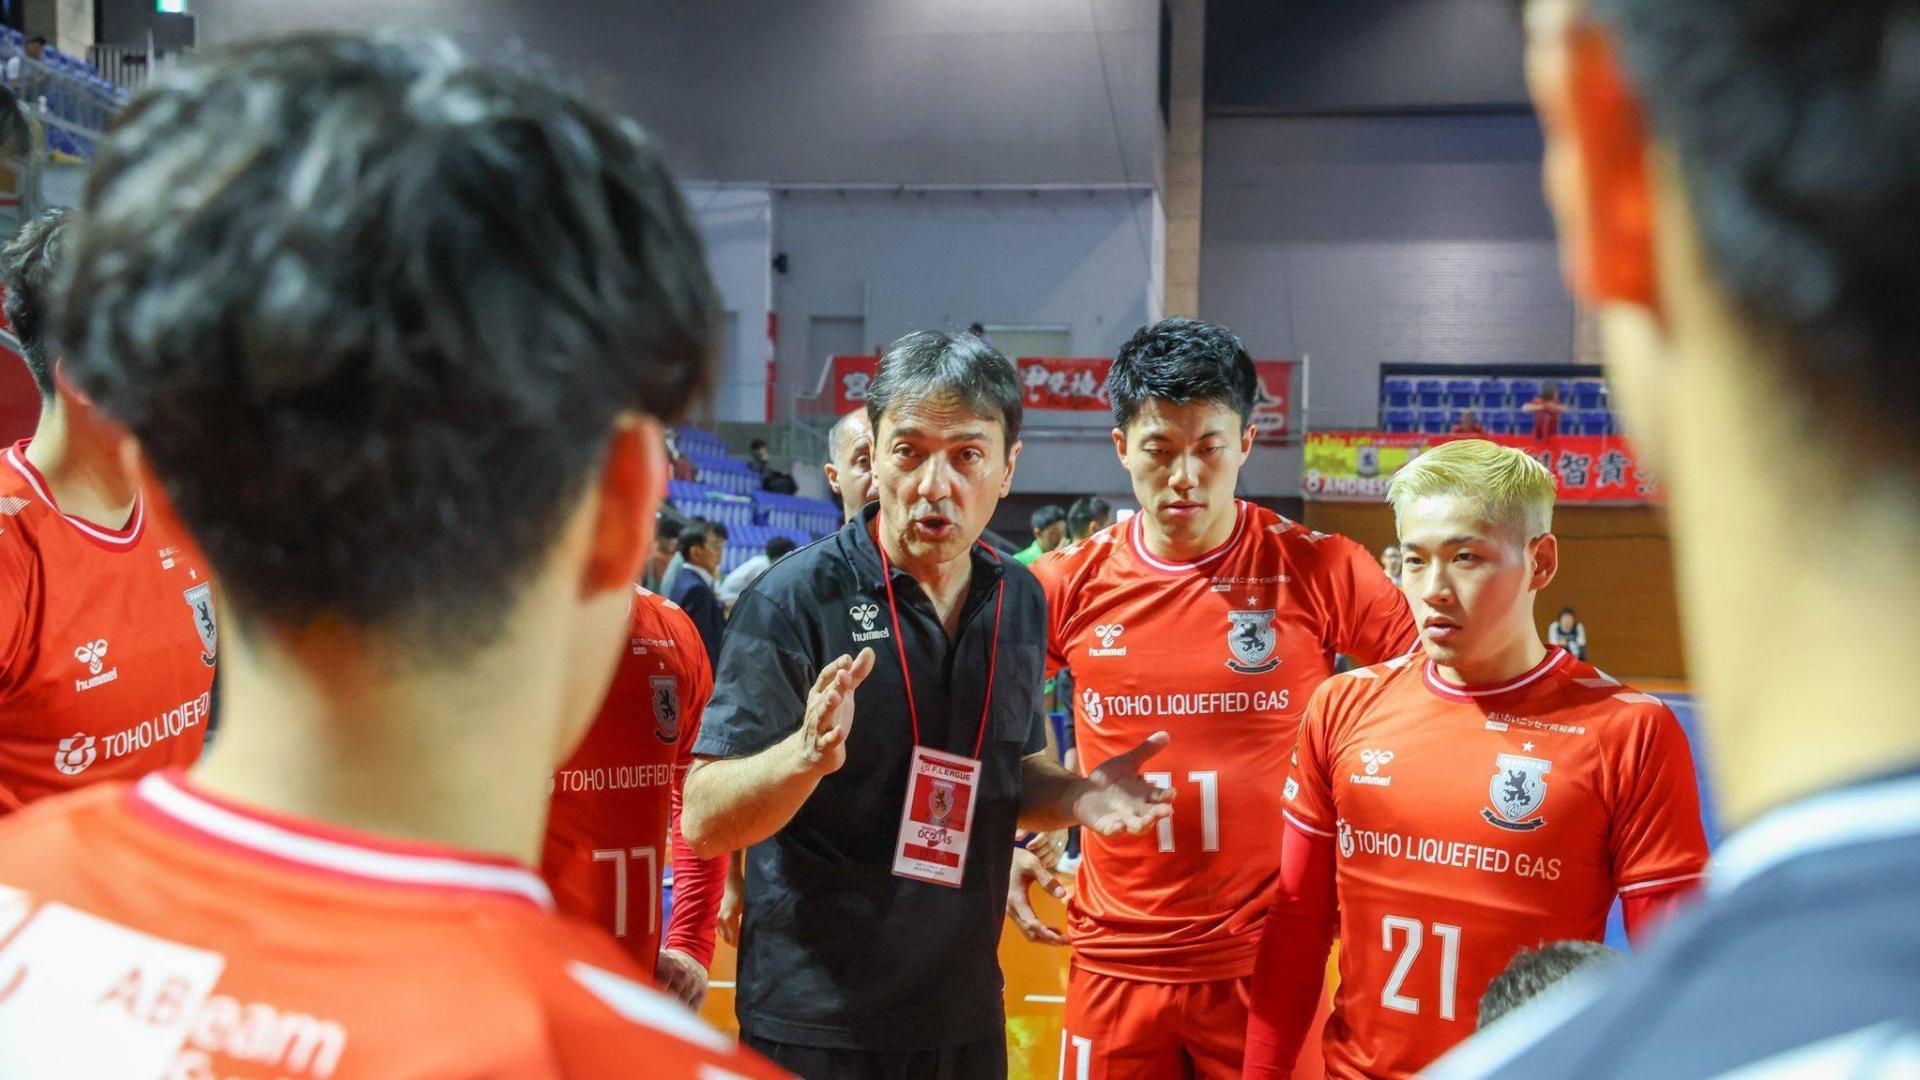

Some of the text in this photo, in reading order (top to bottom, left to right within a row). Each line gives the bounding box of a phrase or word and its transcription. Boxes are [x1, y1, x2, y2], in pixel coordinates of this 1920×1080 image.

[852, 627, 889, 642] hummel
[1088, 646, 1127, 657] hummel
[76, 667, 117, 692] hummel
[1104, 689, 1289, 717] TOHO LIQUEFIED GAS
[101, 721, 152, 760] TOHO
[560, 768, 605, 792] TOHO
[608, 764, 669, 789] LIQUEFIED
[1350, 773, 1391, 787] hummel
[1354, 830, 1562, 881] TOHO LIQUEFIED GAS
[592, 847, 656, 938] 77
[1381, 913, 1462, 1021] 21
